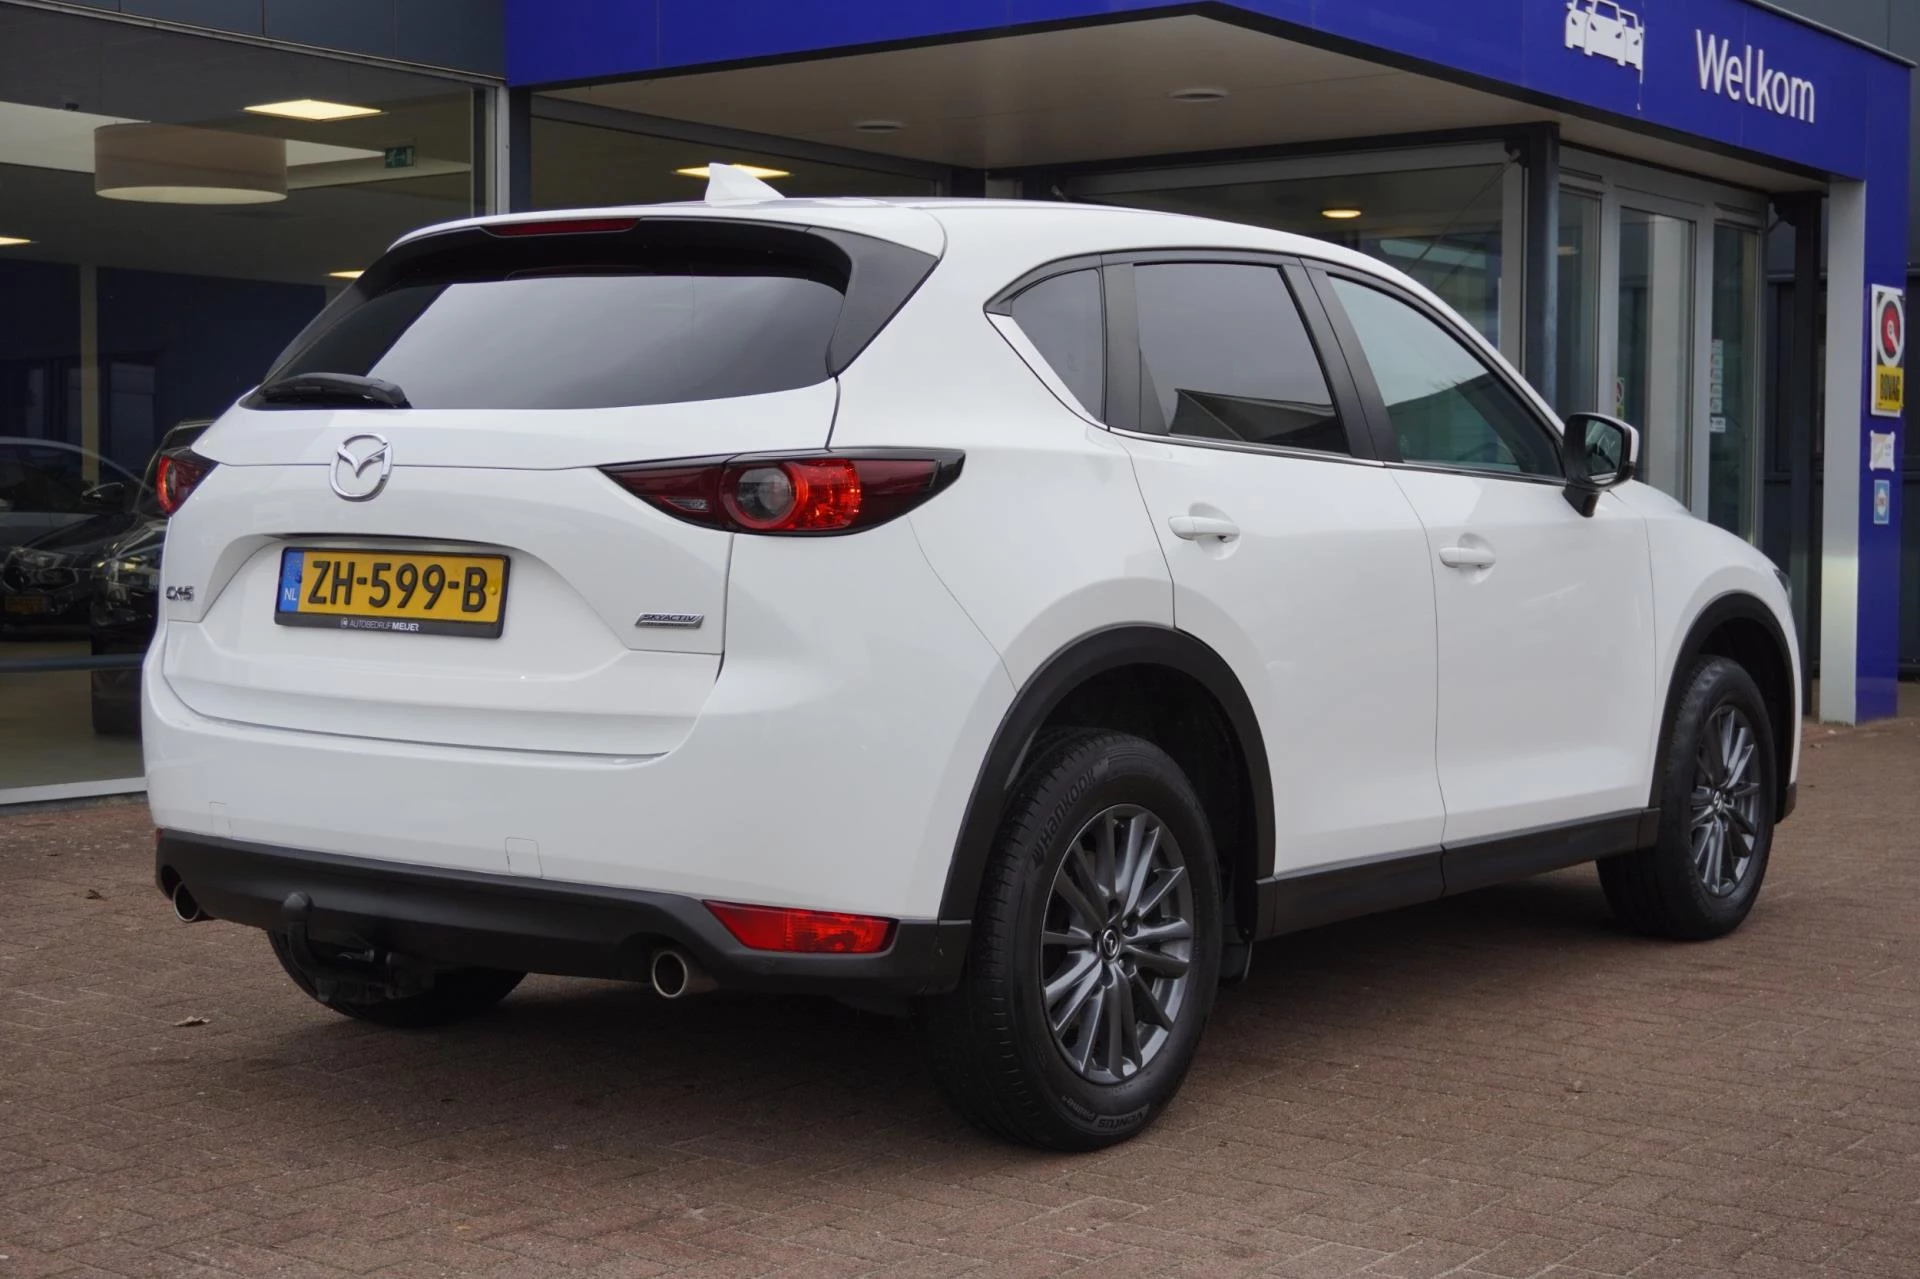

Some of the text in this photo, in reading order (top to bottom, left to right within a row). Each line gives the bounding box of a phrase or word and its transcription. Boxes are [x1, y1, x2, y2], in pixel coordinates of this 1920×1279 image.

[1695, 28, 1815, 124] Welkom
[284, 587, 297, 601] NL
[308, 560, 488, 613] ZH-599-B
